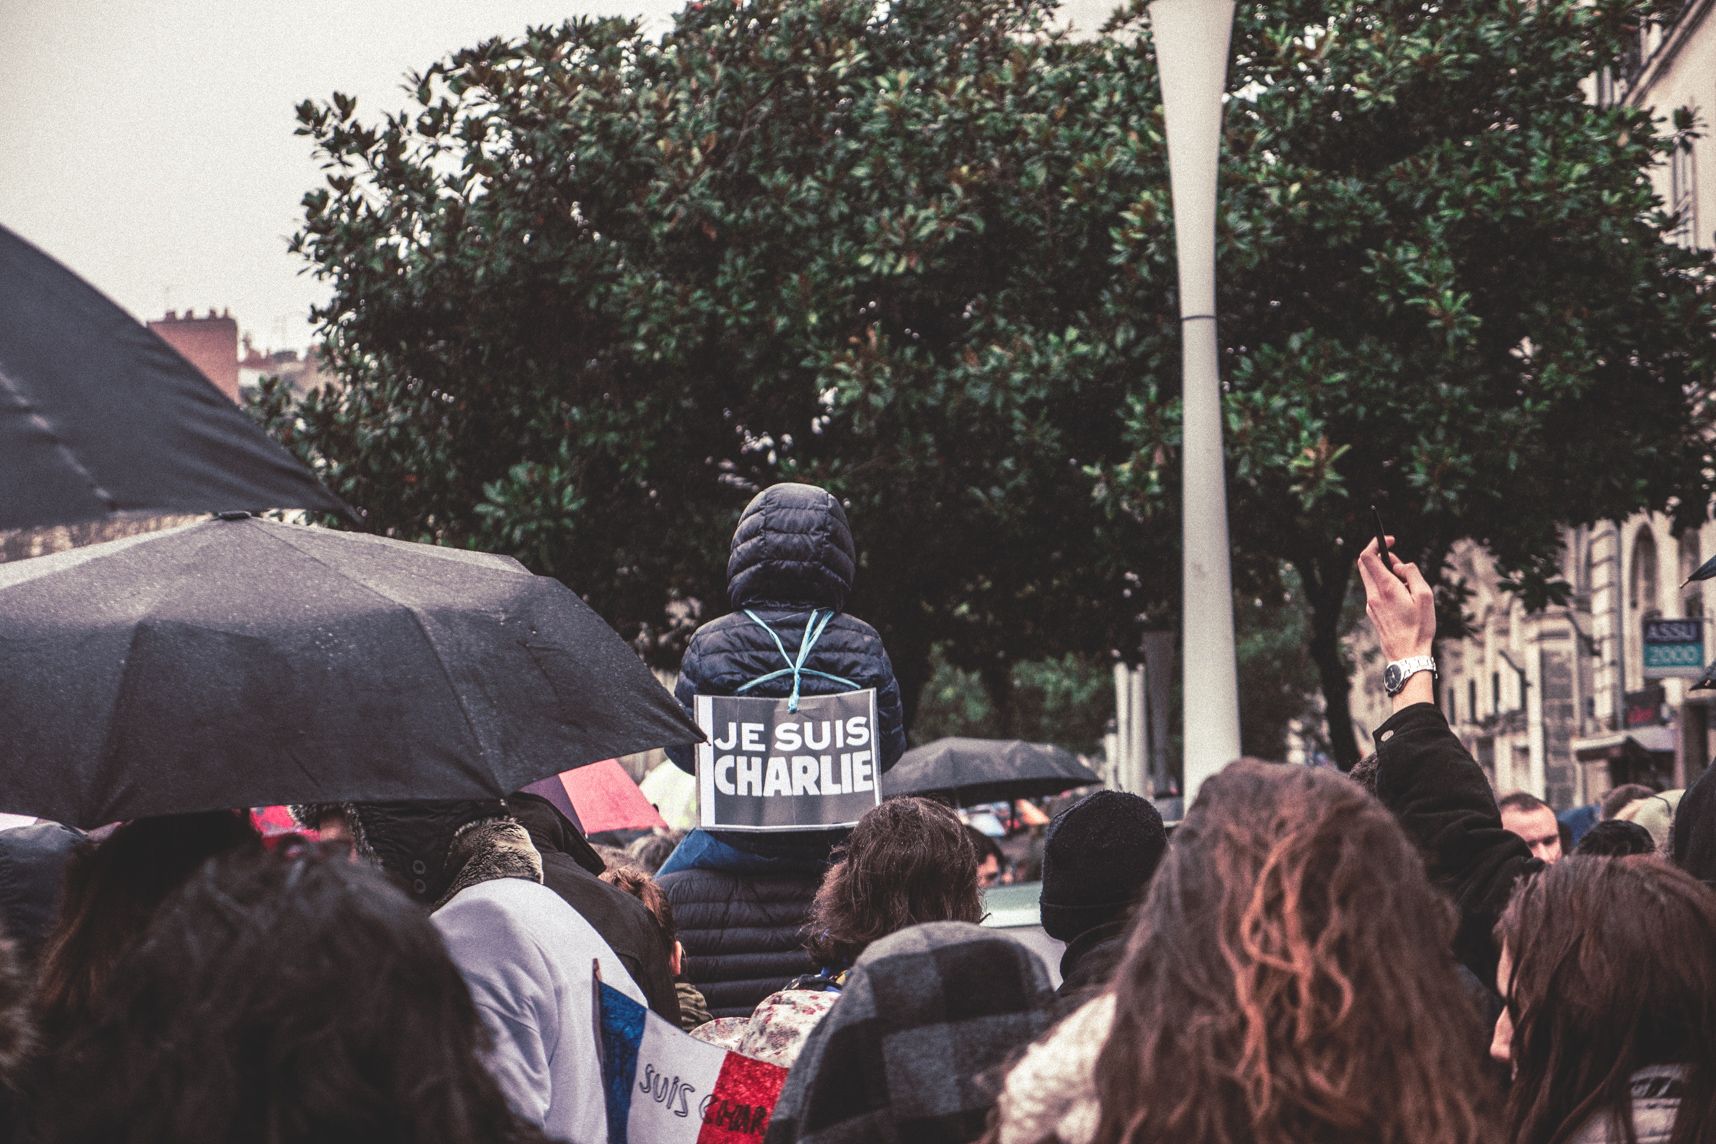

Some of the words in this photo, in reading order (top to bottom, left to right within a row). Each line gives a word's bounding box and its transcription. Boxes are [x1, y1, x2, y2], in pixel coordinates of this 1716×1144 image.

[1646, 623, 1696, 641] ASSU
[1648, 646, 1697, 663] 2000
[714, 722, 766, 751] JE
[774, 716, 870, 751] SUIS
[715, 751, 873, 797] CHARLIE
